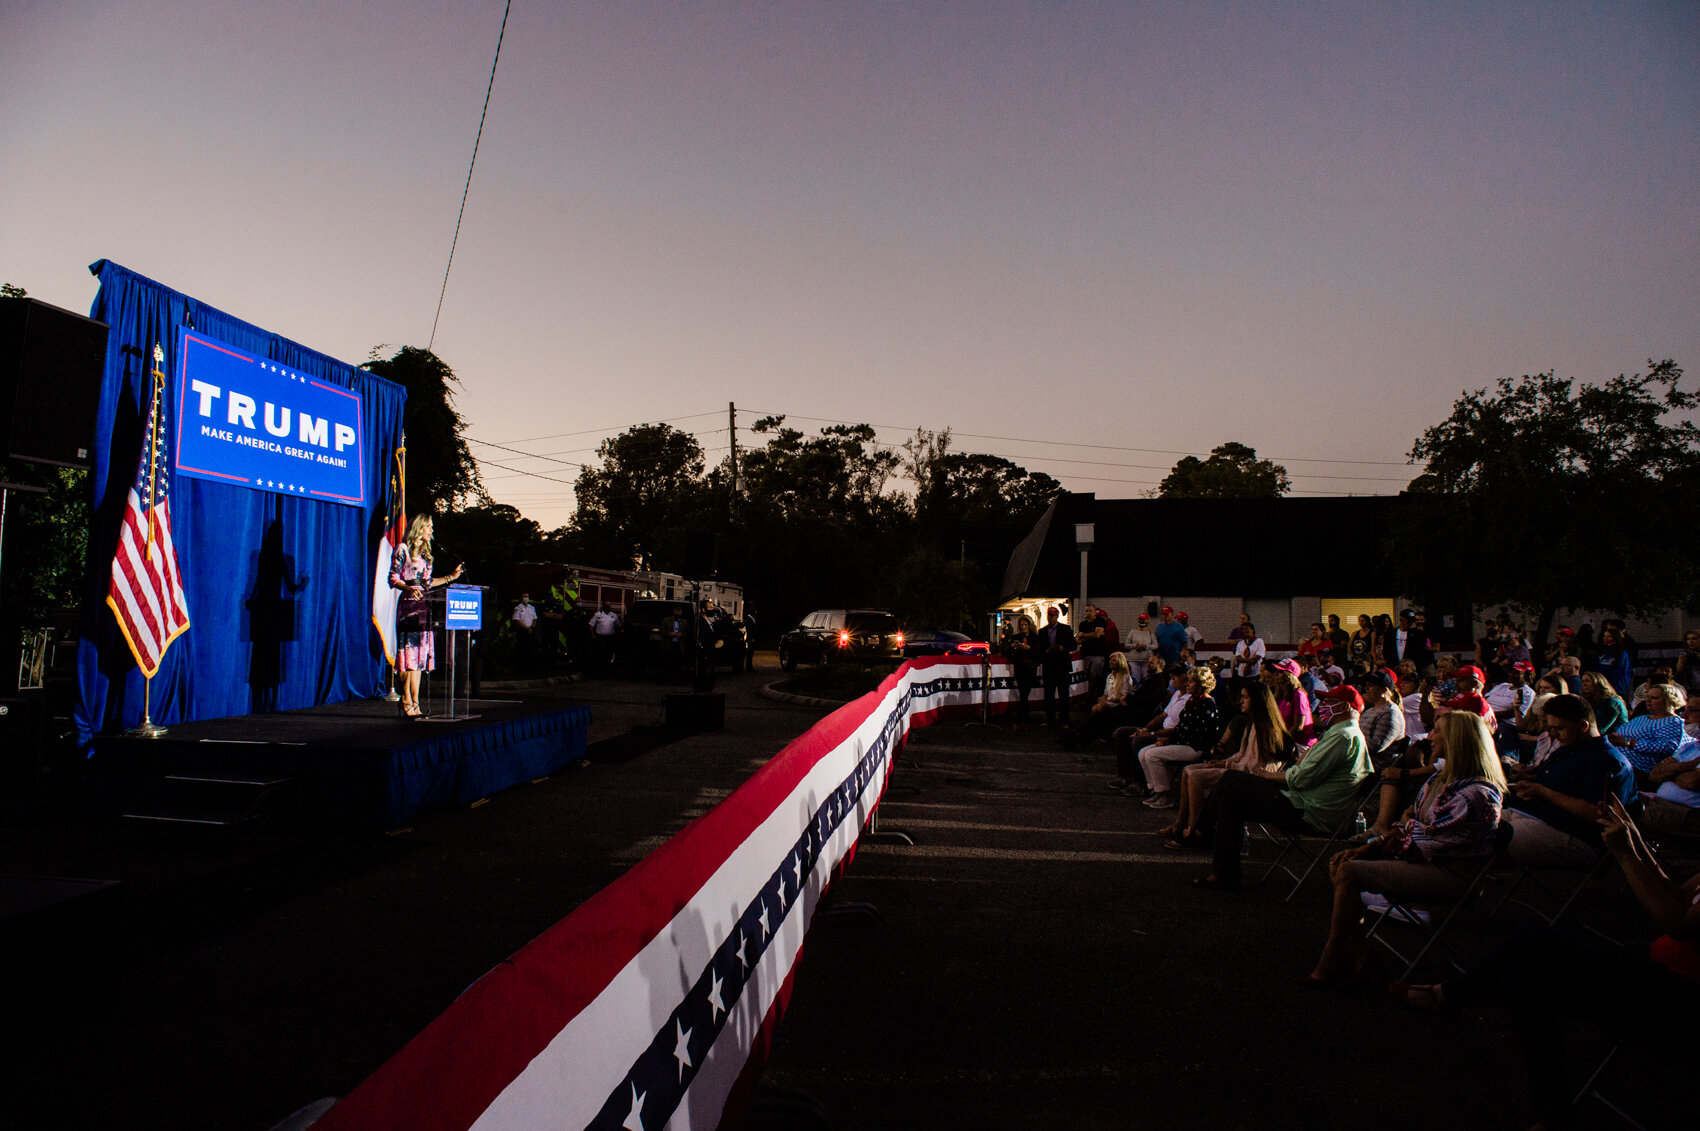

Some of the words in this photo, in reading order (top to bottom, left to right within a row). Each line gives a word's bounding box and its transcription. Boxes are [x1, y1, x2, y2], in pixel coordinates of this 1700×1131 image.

[192, 379, 356, 452] TRUMP
[201, 425, 233, 442] MAKE
[235, 434, 282, 454] AMERICA
[284, 446, 314, 461] GREAT
[316, 454, 347, 468] AGAIN!
[449, 600, 478, 610] TRUMP
